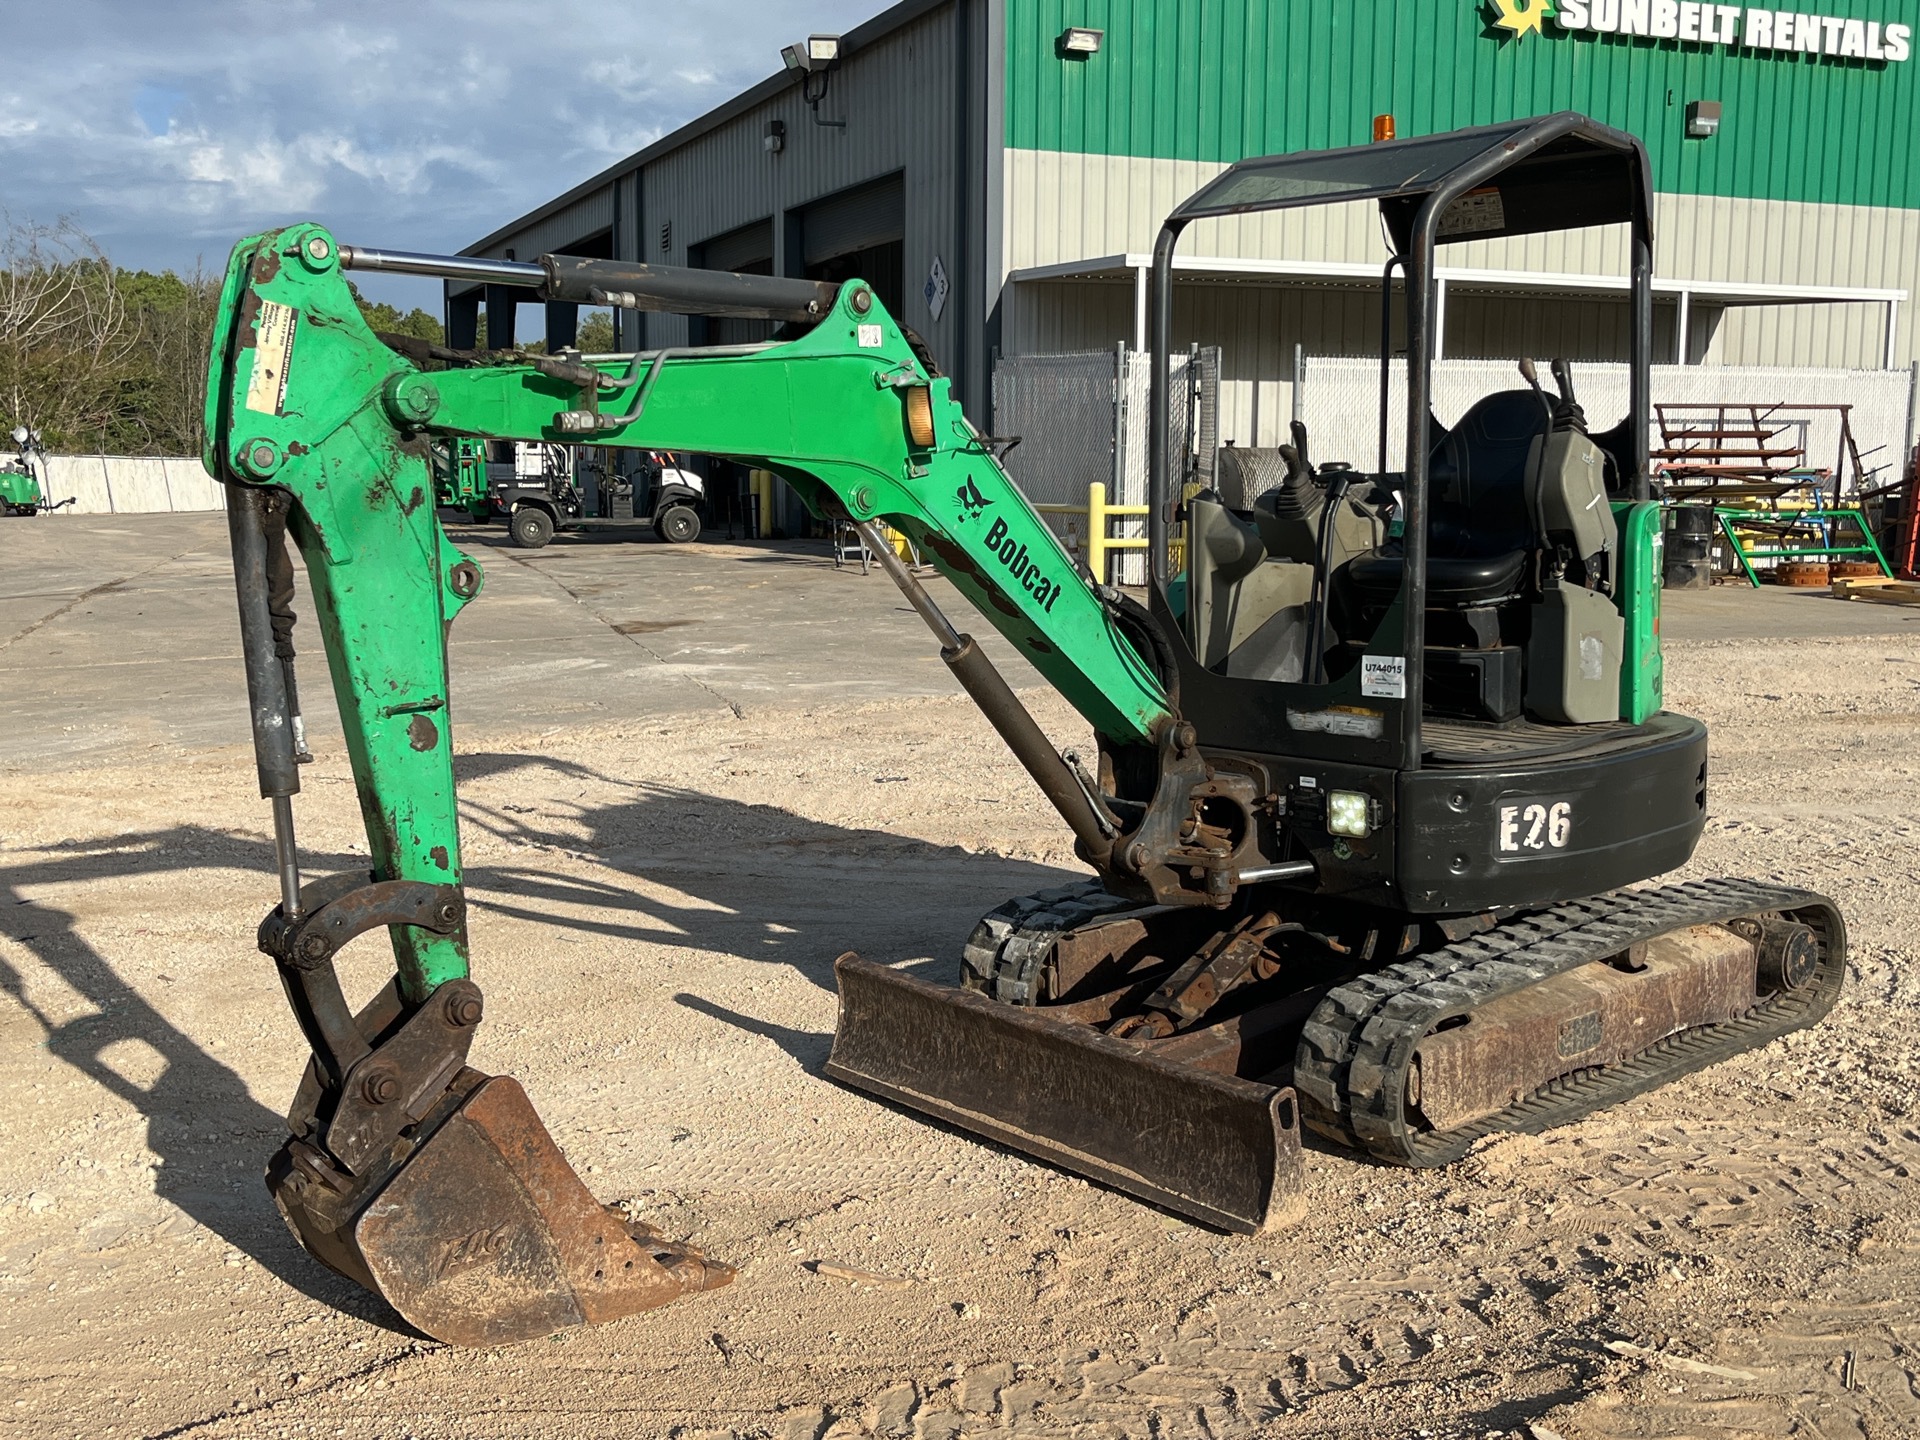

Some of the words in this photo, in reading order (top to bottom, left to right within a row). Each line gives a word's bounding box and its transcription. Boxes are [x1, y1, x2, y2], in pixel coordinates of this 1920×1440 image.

[1560, 0, 1740, 45] SUNBELT
[1744, 8, 1910, 62] RENTALS
[984, 516, 1062, 614] Bobcat
[1365, 664, 1402, 674] U744015
[1500, 802, 1571, 851] E26
